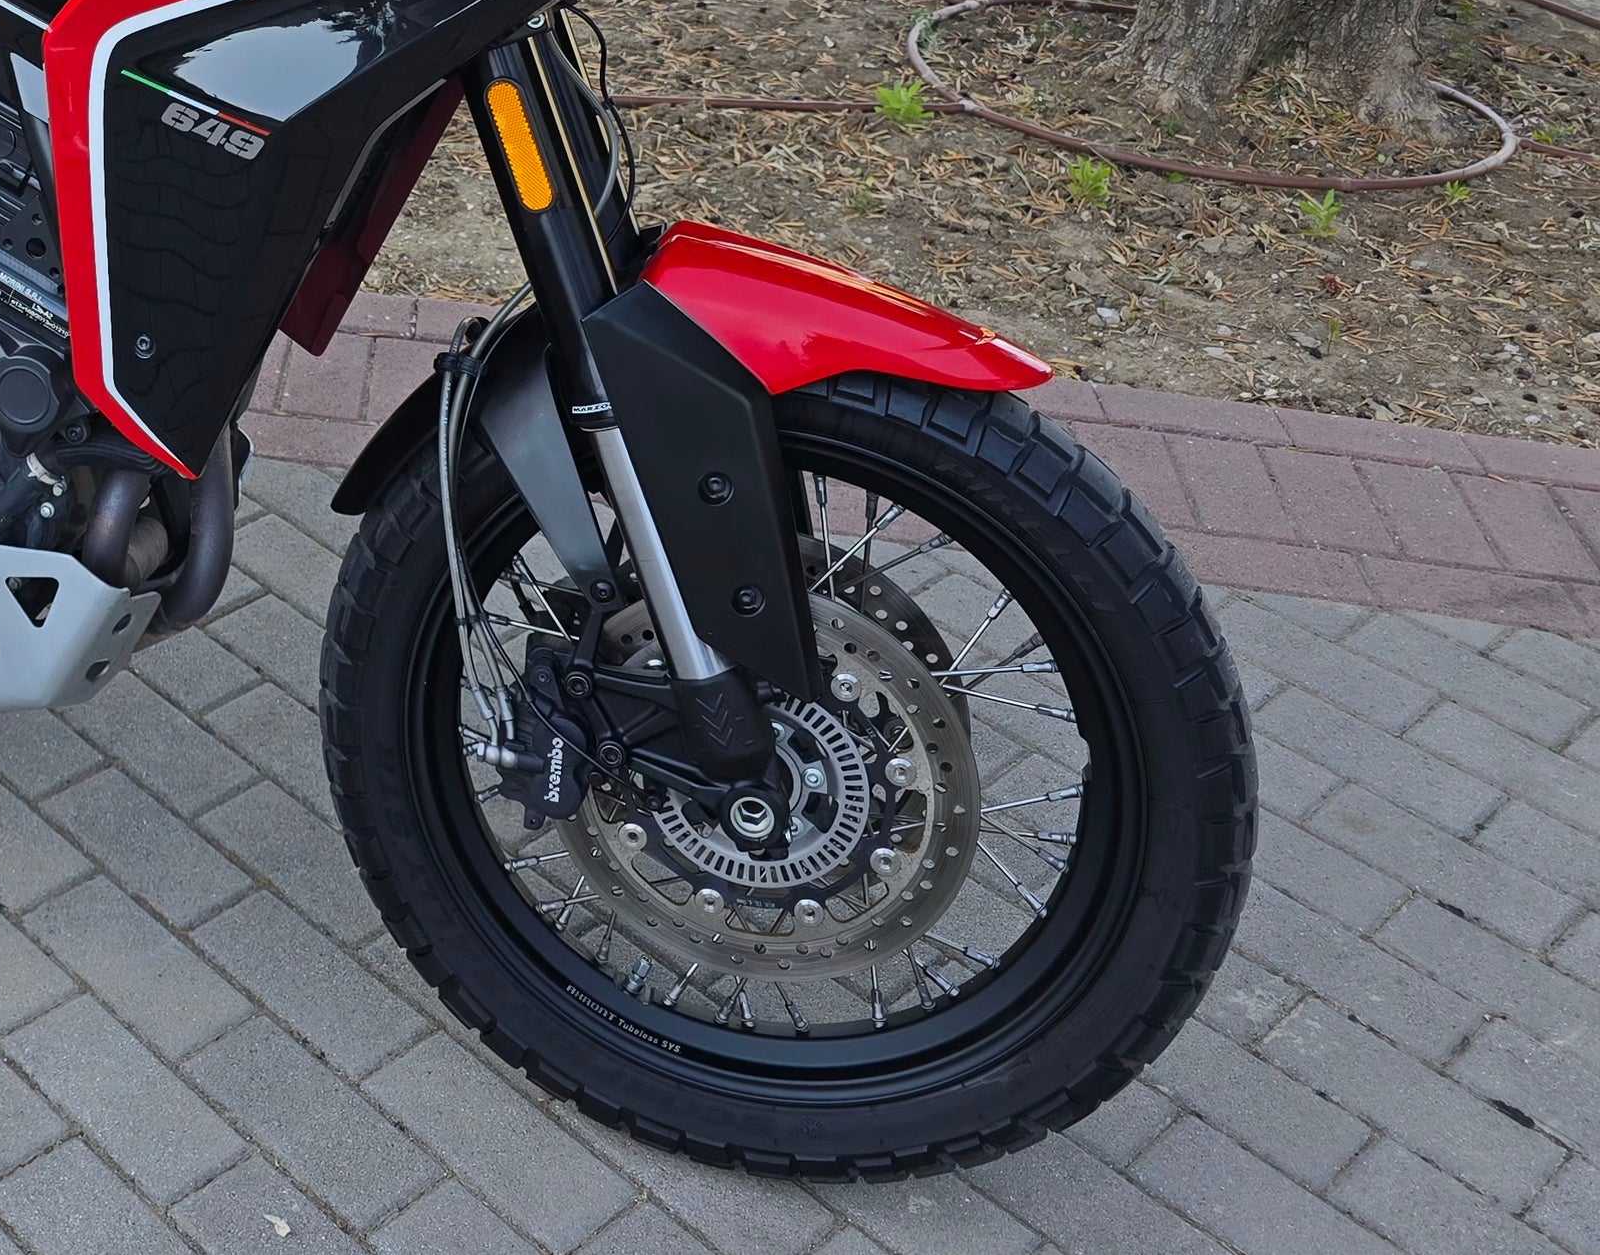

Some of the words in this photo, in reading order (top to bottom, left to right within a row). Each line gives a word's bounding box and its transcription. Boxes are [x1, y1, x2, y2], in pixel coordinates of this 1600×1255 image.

[160, 102, 266, 161] 649
[0, 272, 26, 294] MORINI
[934, 456, 1117, 613] PIRELLI
[543, 737, 564, 803] brembo
[618, 1018, 659, 1044] Tubeless
